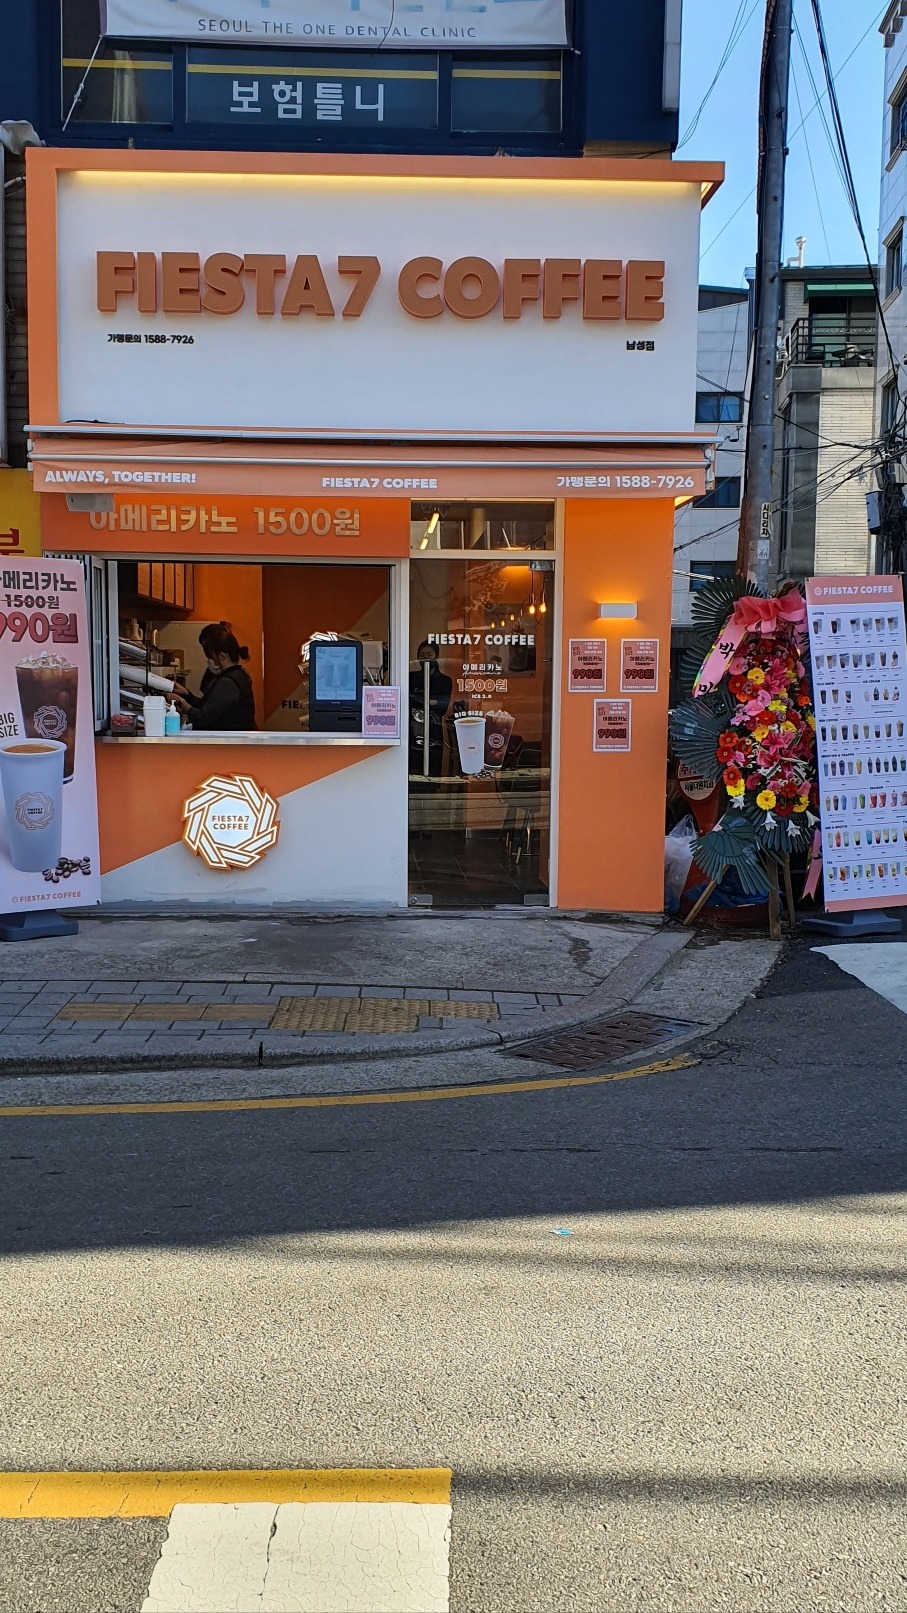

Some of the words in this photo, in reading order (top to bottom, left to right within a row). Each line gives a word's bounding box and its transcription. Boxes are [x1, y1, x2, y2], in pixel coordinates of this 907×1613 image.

[197, 19, 253, 33] SEOUL
[262, 21, 294, 34] THE
[302, 23, 336, 36] ONE
[345, 25, 412, 37] DENTAL
[420, 27, 477, 39] CLINIC
[230, 80, 384, 122] 보험틀니
[96, 250, 382, 317] FIESTA7
[398, 256, 666, 321] COFFEE
[107, 333, 142, 344] 가맹문의
[144, 334, 195, 345] 1588-7926
[626, 340, 655, 351] 남성점
[45, 470, 109, 484] ALWAYS,
[112, 471, 196, 484] TOGETHER!
[322, 477, 380, 488] FIESTA7
[383, 478, 438, 489] COFFEE
[557, 475, 610, 488] 가맹문의
[614, 476, 695, 489] 1588-7926
[253, 506, 360, 536] 1500원
[0, 570, 77, 592] 메리카노
[823, 587, 859, 595] FIESTA7
[860, 585, 894, 594] COFFEE
[427, 633, 482, 645] FIESTA7
[484, 634, 535, 646] COFFEE
[456, 678, 508, 692] 1500원
[19, 893, 51, 903] FIESTA7
[52, 891, 82, 900] COFFEE
